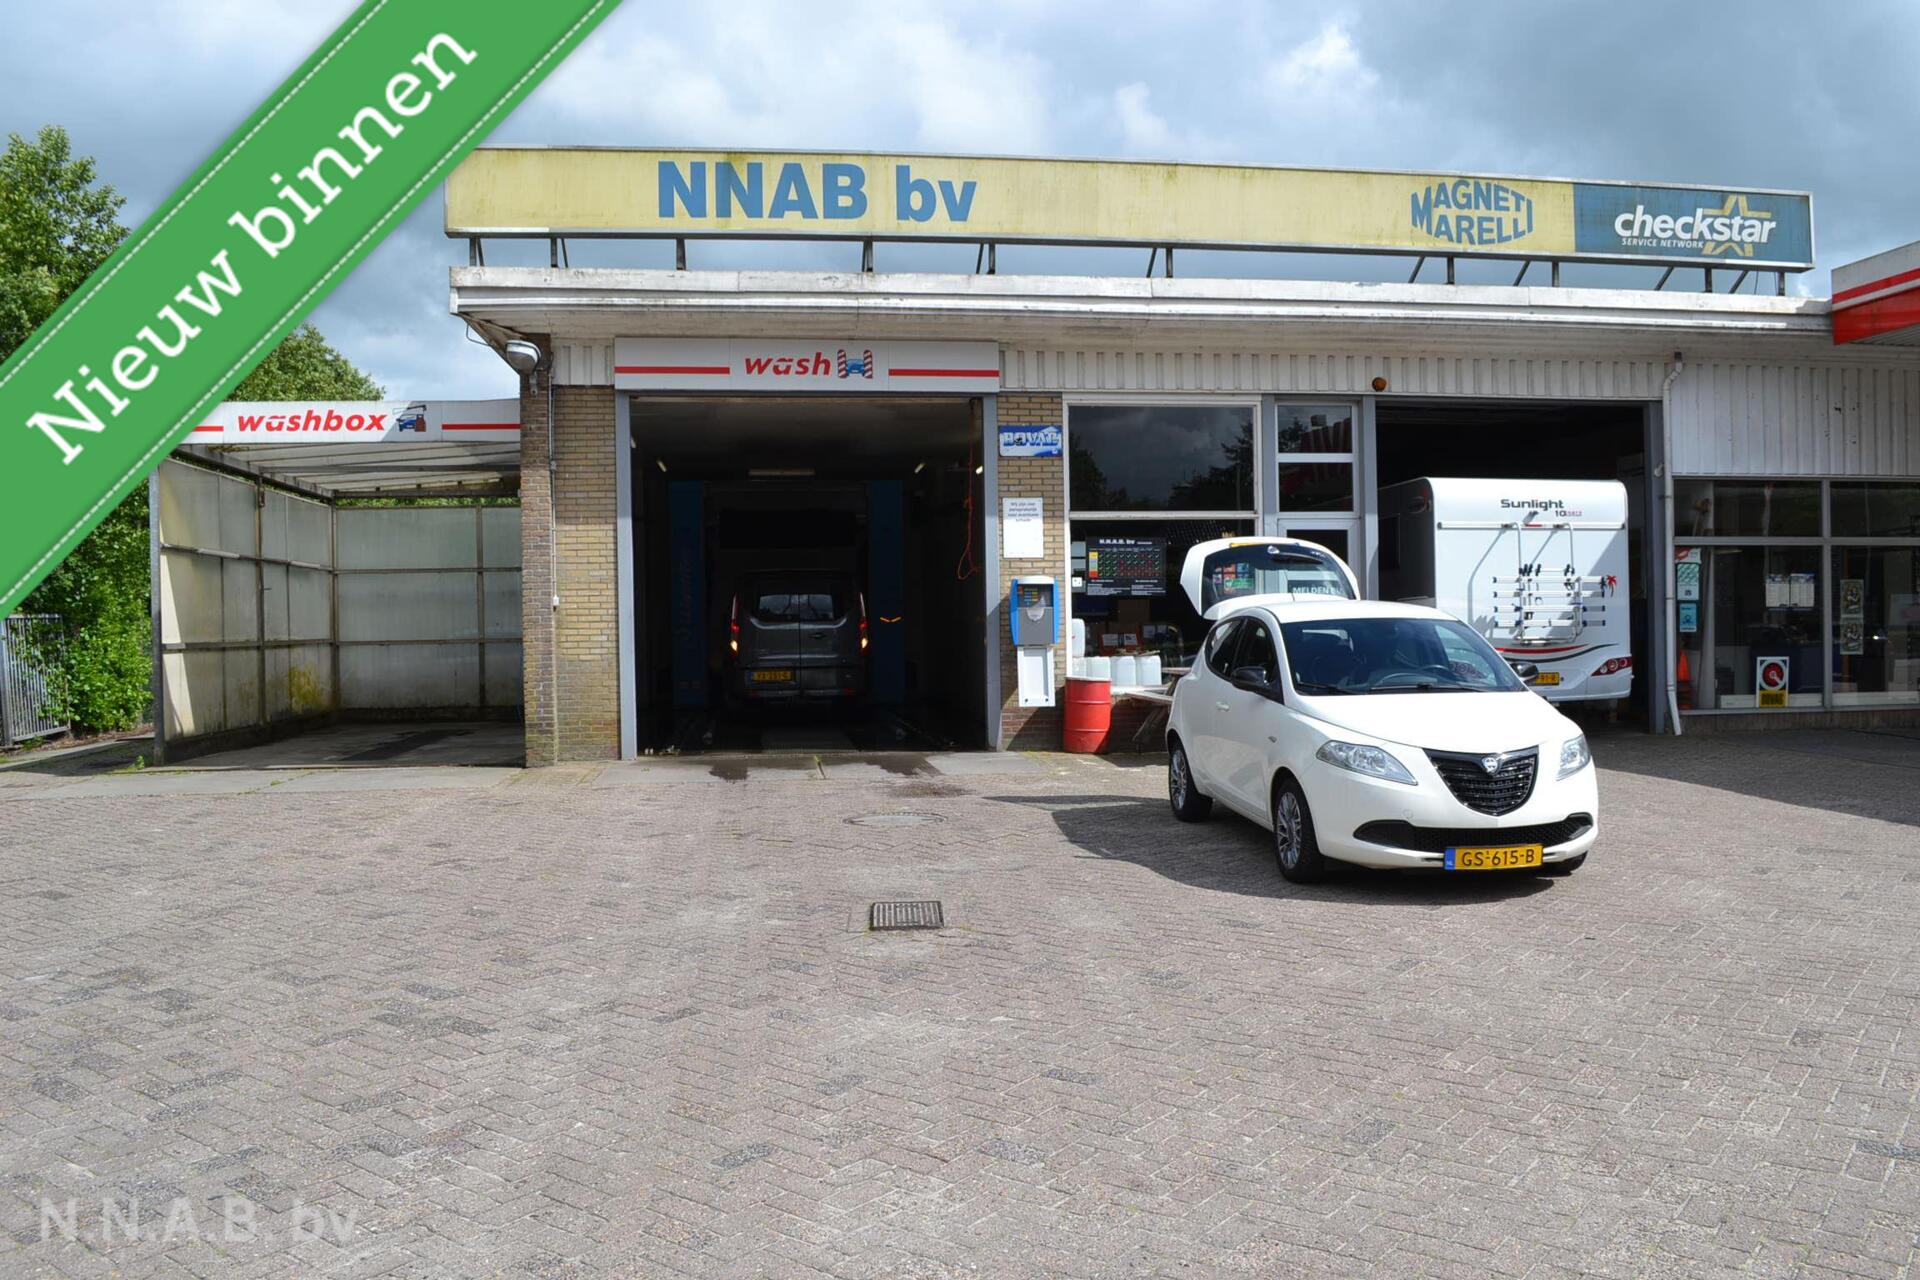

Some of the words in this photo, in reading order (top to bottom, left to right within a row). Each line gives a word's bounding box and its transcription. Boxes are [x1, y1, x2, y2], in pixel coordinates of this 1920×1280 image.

[658, 161, 868, 220] NNAB
[896, 165, 977, 222] bv
[1411, 179, 1534, 224] MAGNETI
[1411, 200, 1534, 245] MARELLI
[1614, 205, 1777, 244] checkstar
[1621, 238, 1658, 248] SERVICE
[1659, 239, 1704, 249] NETWORK
[745, 352, 831, 377] wash
[236, 410, 388, 433] washbox
[1501, 499, 1564, 511] Sunlight
[1462, 849, 1535, 867] GS-615-B
